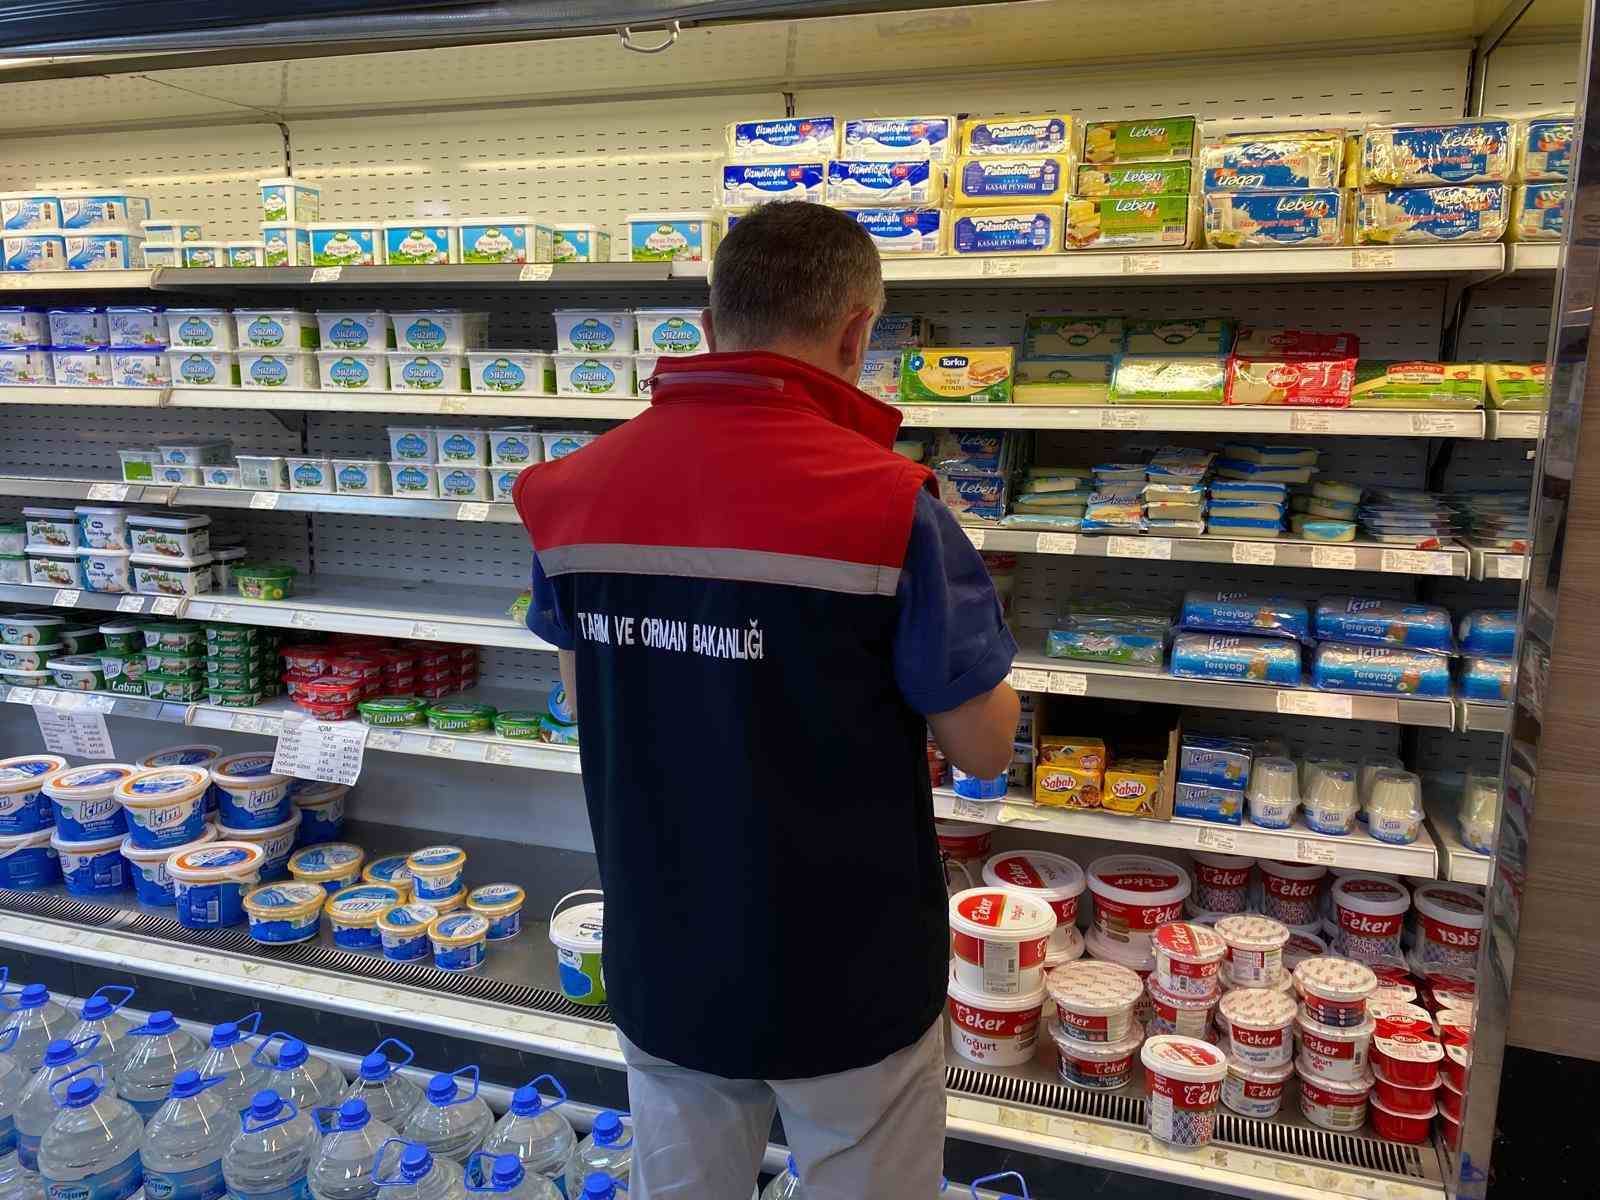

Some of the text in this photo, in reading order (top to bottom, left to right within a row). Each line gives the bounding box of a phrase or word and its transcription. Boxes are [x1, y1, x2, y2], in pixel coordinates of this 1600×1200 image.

[1129, 126, 1165, 138] Leben
[1123, 171, 1162, 184] Leben
[1218, 173, 1265, 188] Leben
[1115, 199, 1155, 213] Leben
[1277, 197, 1327, 213] Leben
[575, 329, 609, 341] Süzme
[660, 327, 694, 340] Süzme
[942, 357, 966, 368] Torku
[490, 370, 518, 381] Süzme
[576, 371, 609, 383] Süzme
[960, 484, 999, 497] Leben
[614, 615, 635, 646] VE
[640, 616, 687, 653] ORMAN
[693, 617, 764, 661] BAKANLIĞI
[1042, 776, 1075, 789] Sabah
[1112, 784, 1145, 795] Sabah
